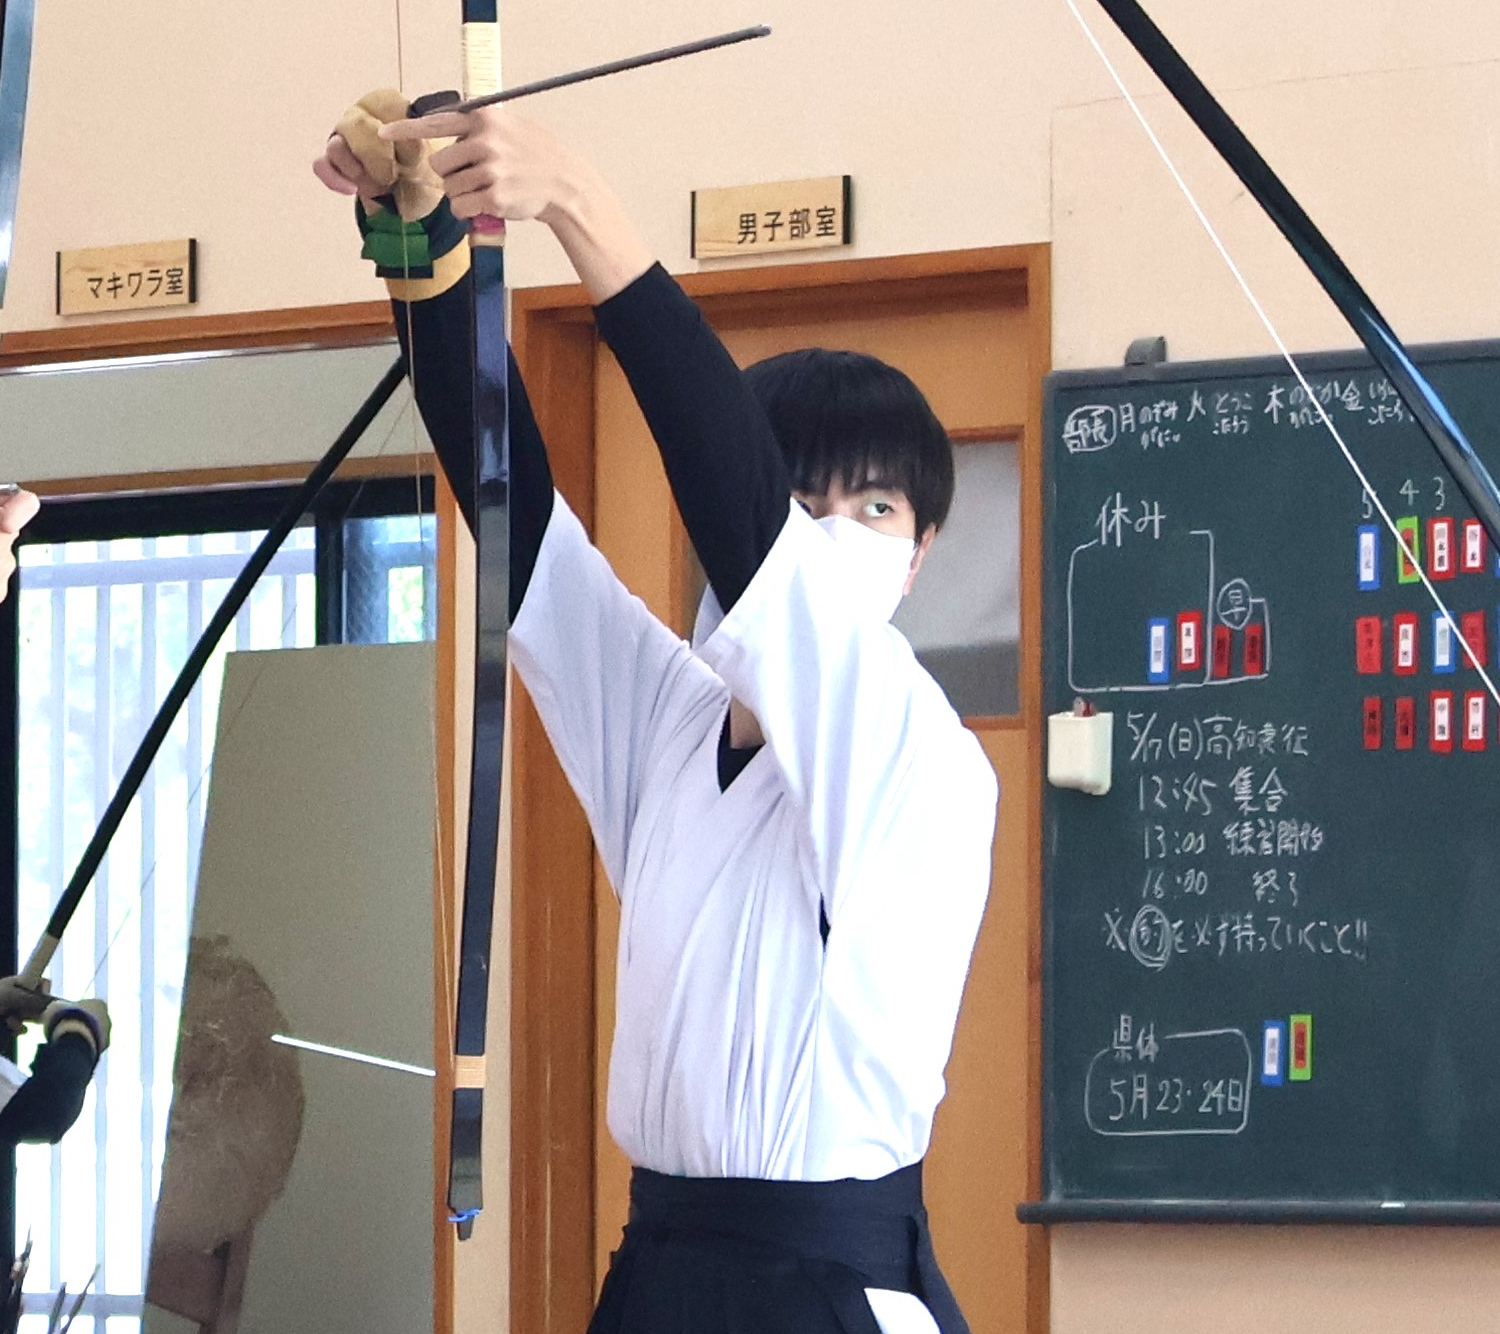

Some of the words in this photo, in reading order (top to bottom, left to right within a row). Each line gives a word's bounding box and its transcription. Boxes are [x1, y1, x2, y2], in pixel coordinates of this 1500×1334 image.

[736, 205, 837, 245] 男子部室
[86, 266, 186, 299] マキワラ室
[1264, 383, 1285, 424] 木
[1341, 380, 1364, 411] 金
[1399, 478, 1420, 506] 4
[1432, 476, 1447, 511] 3
[1096, 491, 1168, 547] 休み
[1139, 771, 1217, 816] 12:45
[1228, 765, 1289, 816] 集合
[1143, 824, 1207, 859] 13:00
[1223, 818, 1324, 856] 練習開始
[1252, 868, 1299, 907] 終了
[1112, 1013, 1160, 1063] 県体
